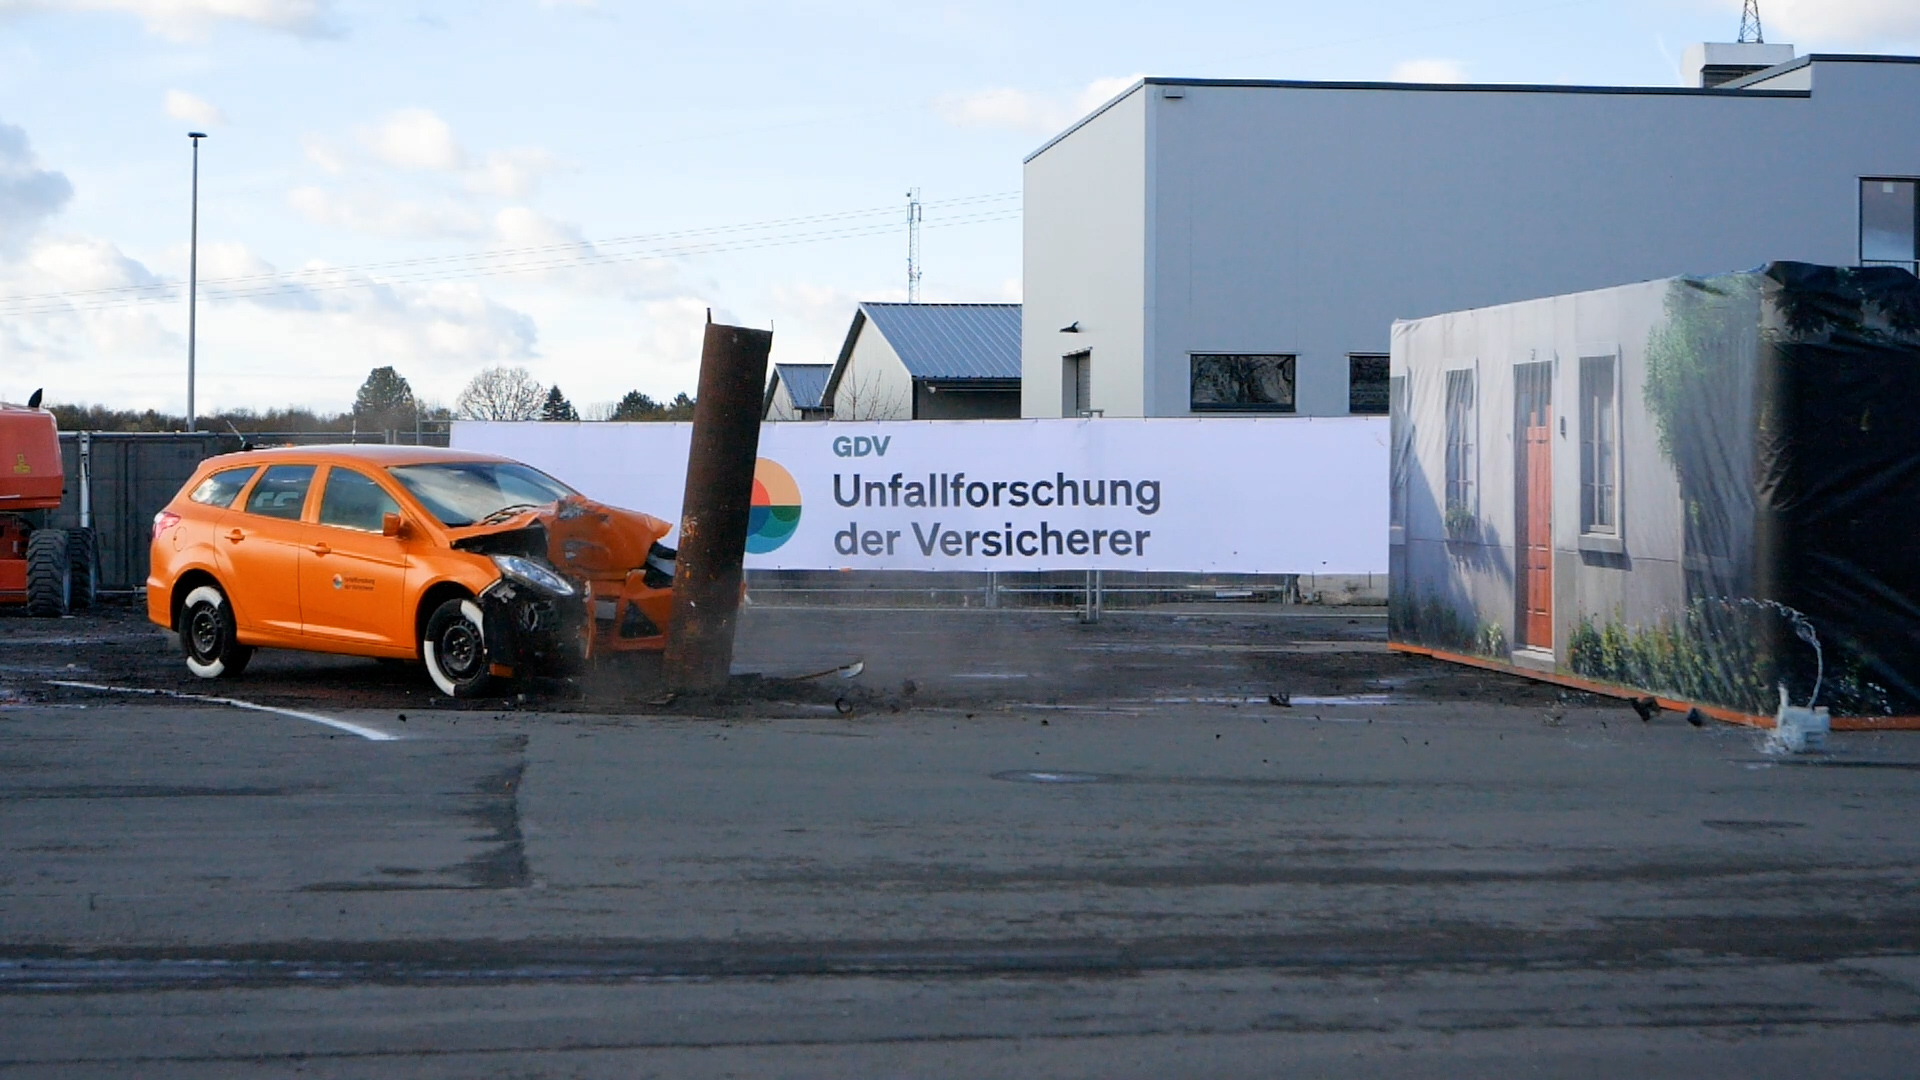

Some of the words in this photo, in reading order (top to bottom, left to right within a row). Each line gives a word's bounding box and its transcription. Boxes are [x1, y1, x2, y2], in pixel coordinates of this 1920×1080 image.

[832, 435, 892, 458] GDV
[833, 472, 1161, 516] Unfallforschung
[834, 521, 901, 556] der
[910, 520, 1151, 557] Versicherer
